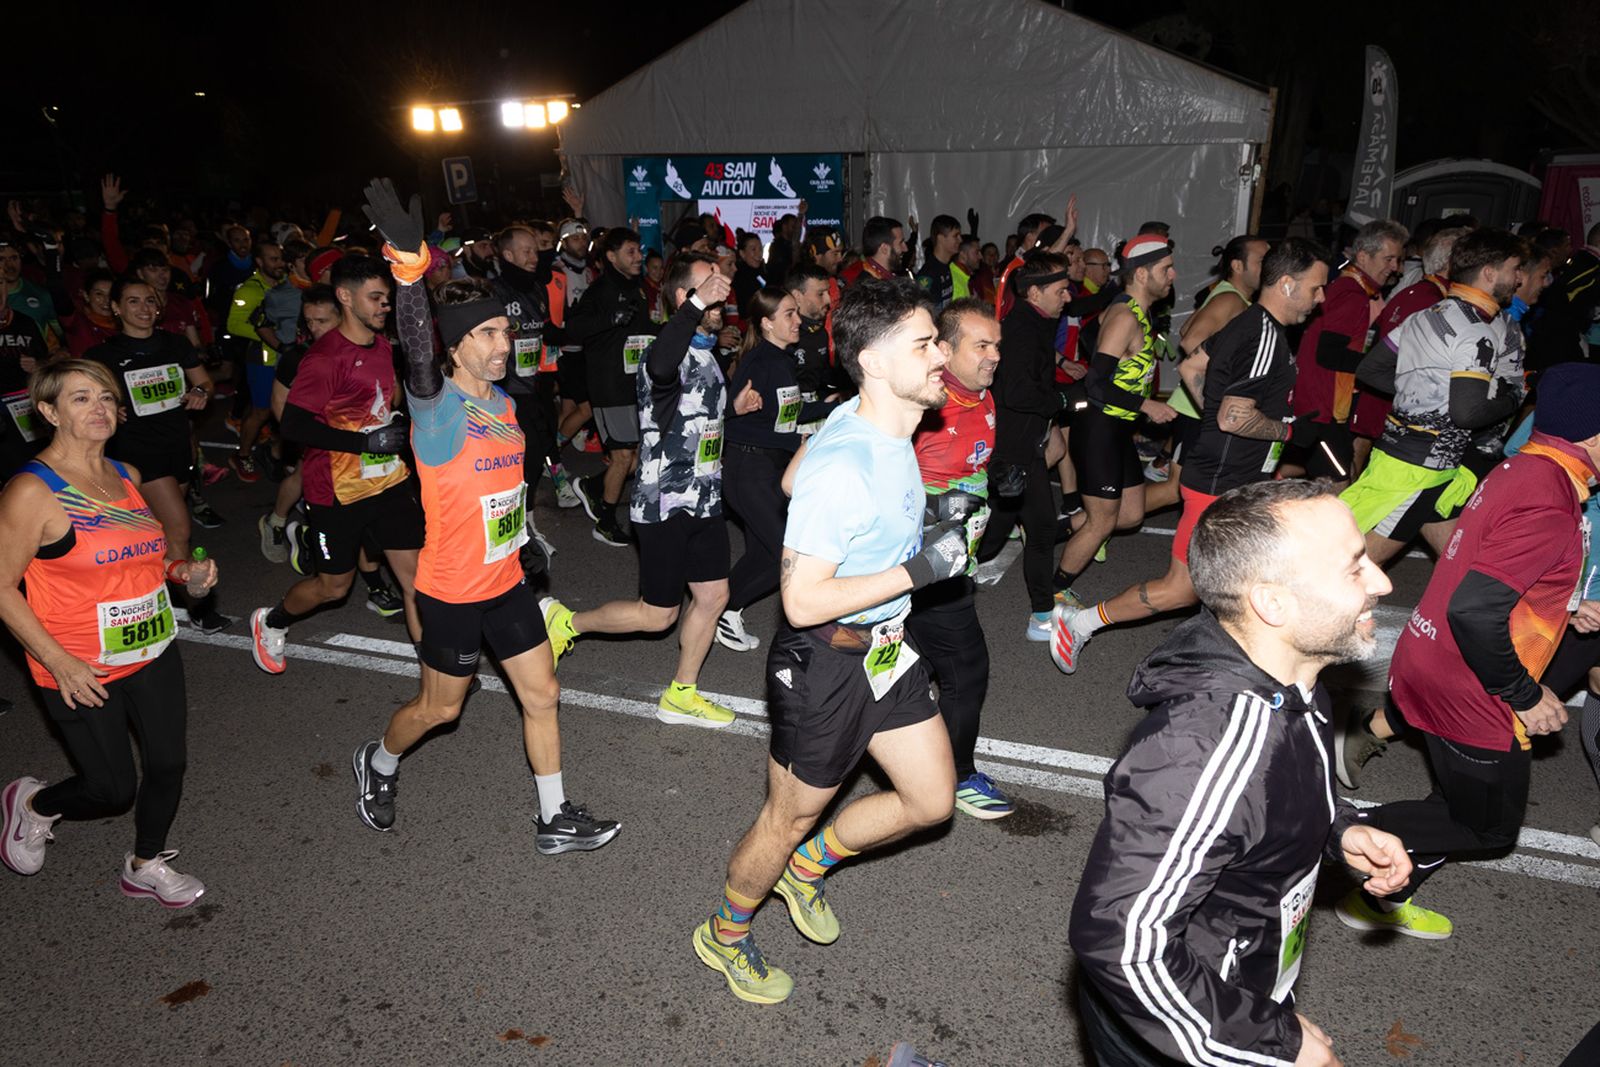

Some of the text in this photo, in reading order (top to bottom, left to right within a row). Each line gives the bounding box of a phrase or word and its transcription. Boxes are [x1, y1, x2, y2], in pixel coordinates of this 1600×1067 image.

[704, 161, 757, 180] 43 SAN
[451, 163, 468, 197] P
[701, 176, 756, 196] ANTÓN
[776, 180, 788, 192] 43
[752, 217, 777, 228] SAN
[807, 217, 840, 226] calderón
[505, 301, 521, 316] 18
[141, 381, 176, 399] 9199
[491, 509, 504, 519] SAN
[121, 604, 146, 617] NOCHE
[111, 618, 129, 627] SAN
[122, 613, 165, 646] 5811
